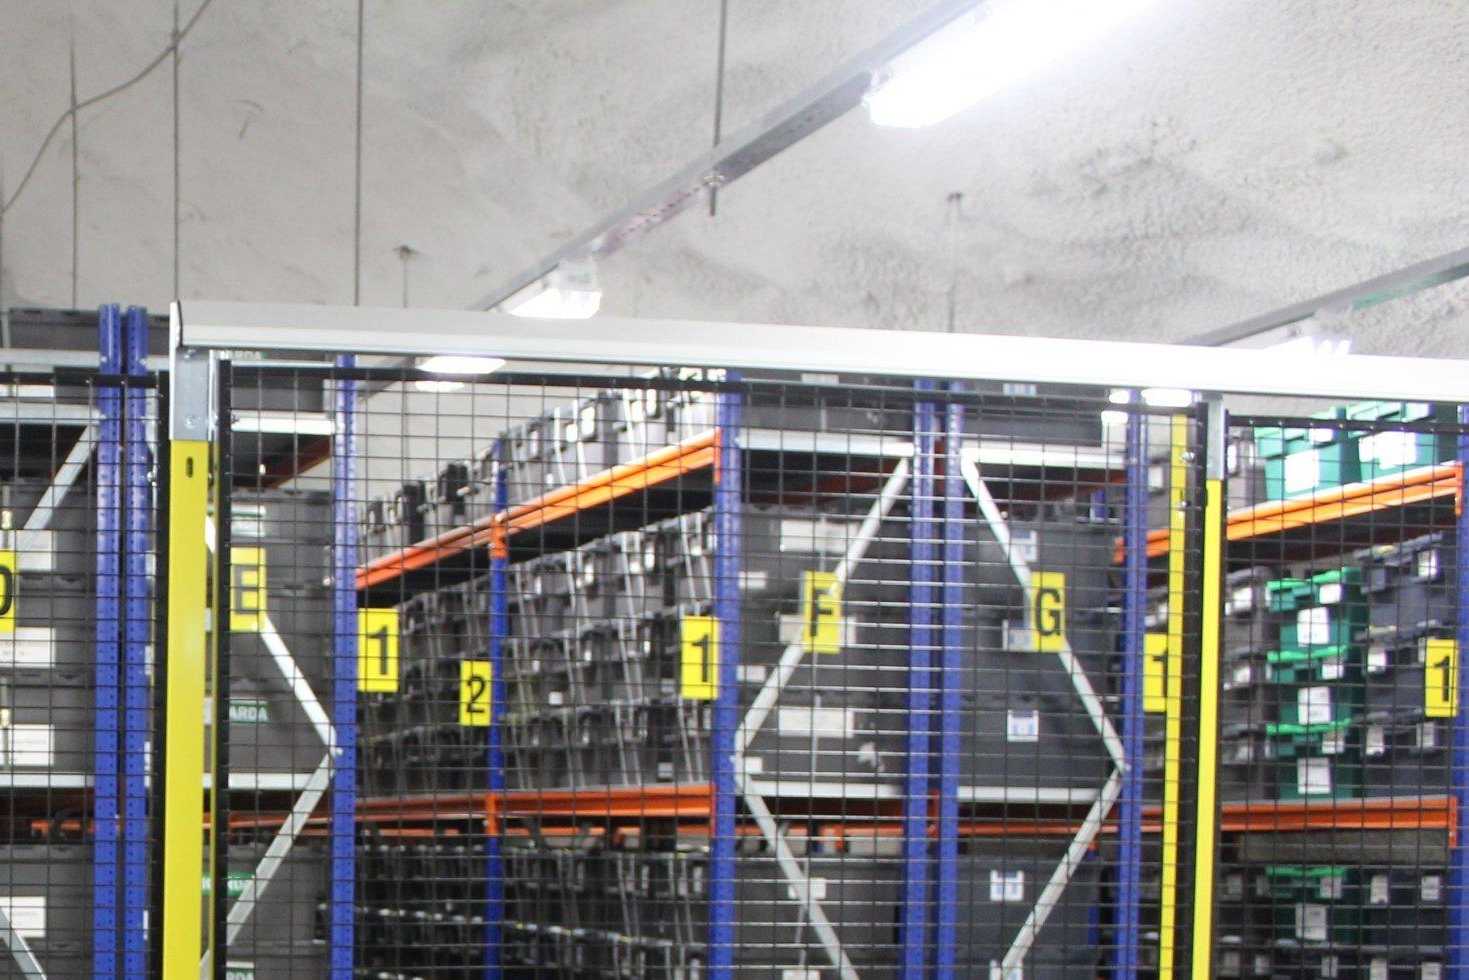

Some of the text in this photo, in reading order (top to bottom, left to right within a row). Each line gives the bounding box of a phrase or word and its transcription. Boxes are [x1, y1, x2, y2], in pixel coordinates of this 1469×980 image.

[234, 565, 259, 614] E
[809, 588, 833, 637] F
[1035, 588, 1062, 636] G
[370, 626, 390, 676] 1
[692, 634, 709, 681] 1
[1153, 650, 1168, 699] 1
[468, 676, 487, 713] 2
[1434, 655, 1450, 701] 1
